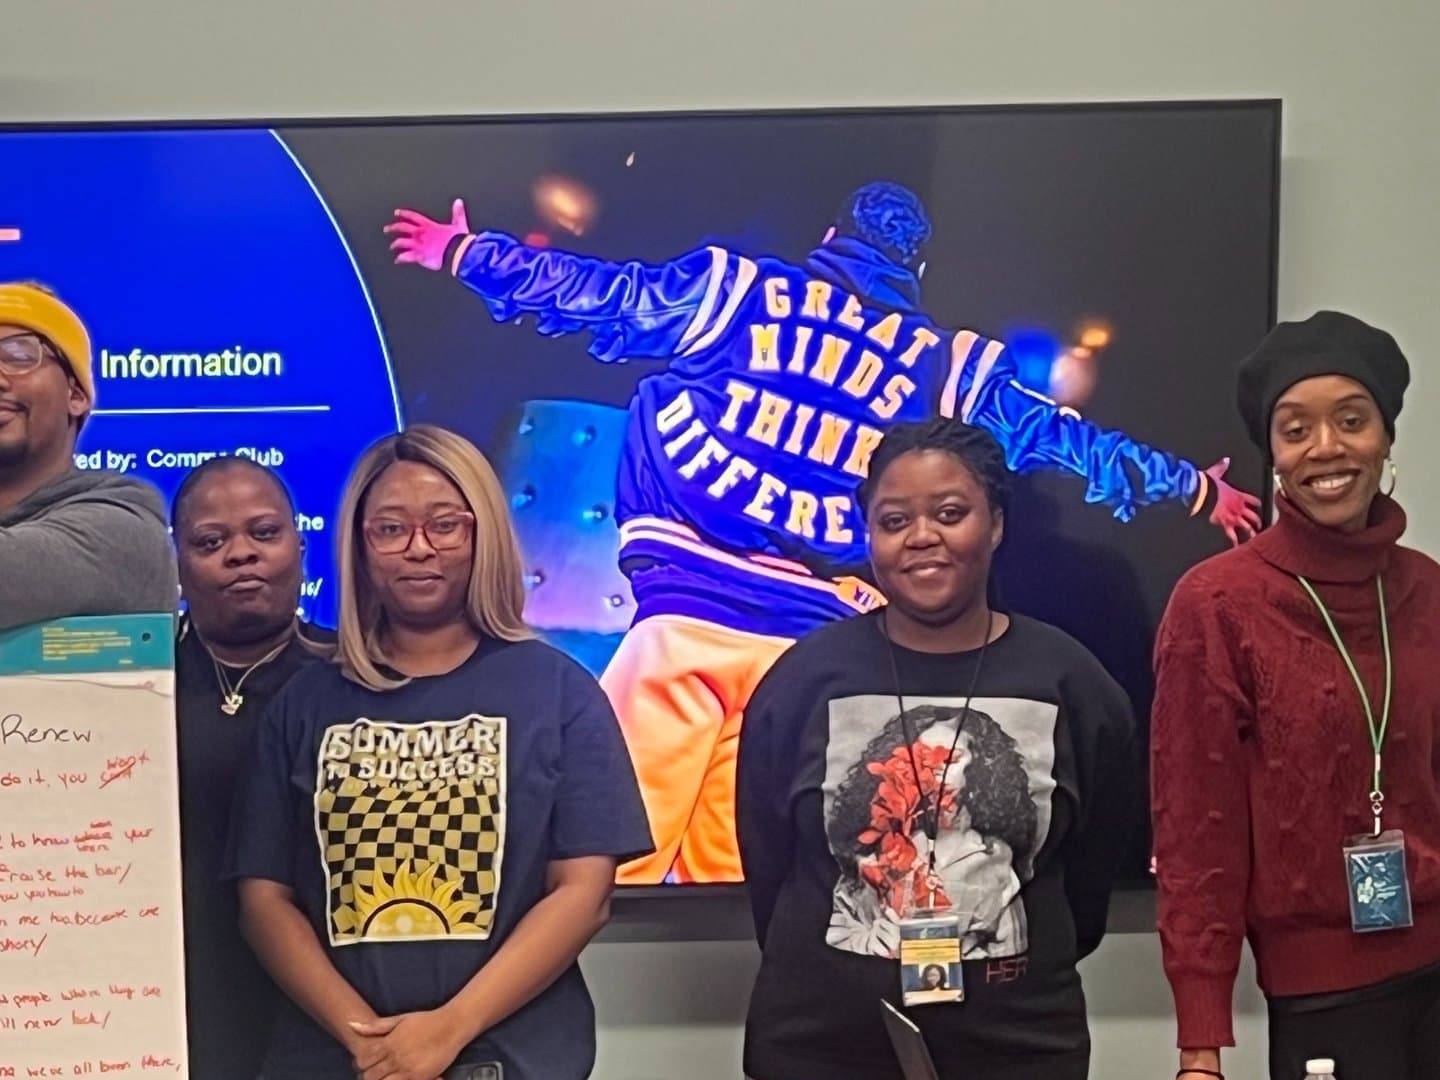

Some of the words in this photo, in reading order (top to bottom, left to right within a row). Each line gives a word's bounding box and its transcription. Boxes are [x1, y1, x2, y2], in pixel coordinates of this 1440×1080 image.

[764, 276, 940, 368] GREAT
[101, 346, 281, 378] Information
[749, 322, 917, 418] MINDS
[717, 380, 884, 480] THINK
[107, 450, 137, 473] by:
[656, 389, 854, 544] DIFFERE
[1, 714, 91, 746] Renew
[326, 721, 497, 760] SUMMER
[58, 773, 88, 788] you
[358, 752, 497, 783] SUCCESS
[10, 832, 26, 848] to
[19, 915, 41, 926] me
